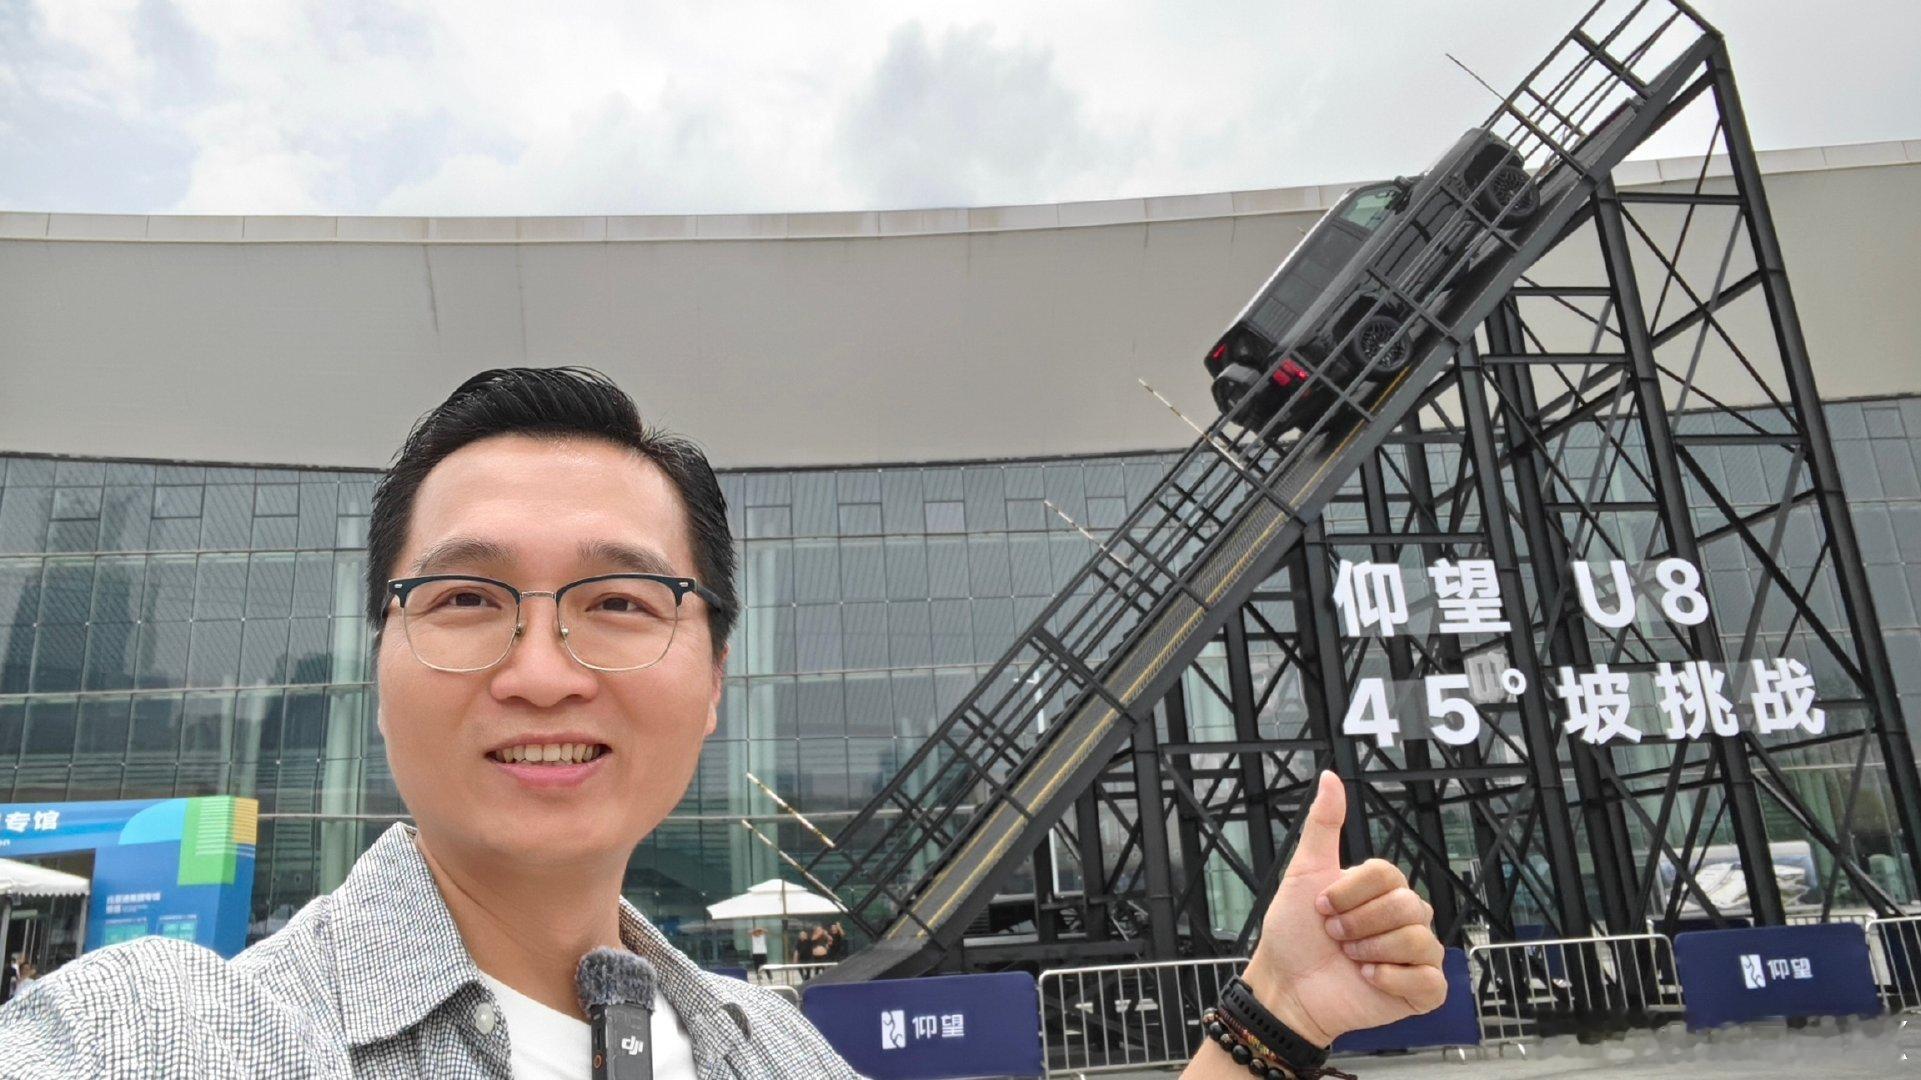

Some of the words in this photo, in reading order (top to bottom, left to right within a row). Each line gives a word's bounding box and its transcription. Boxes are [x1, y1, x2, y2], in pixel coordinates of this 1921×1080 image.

[1333, 559, 1511, 636] 仰望
[1574, 558, 1708, 628] U8
[0, 810, 60, 832] 专馆
[1767, 957, 1813, 980] 仰望
[912, 1013, 965, 1039] 仰望
